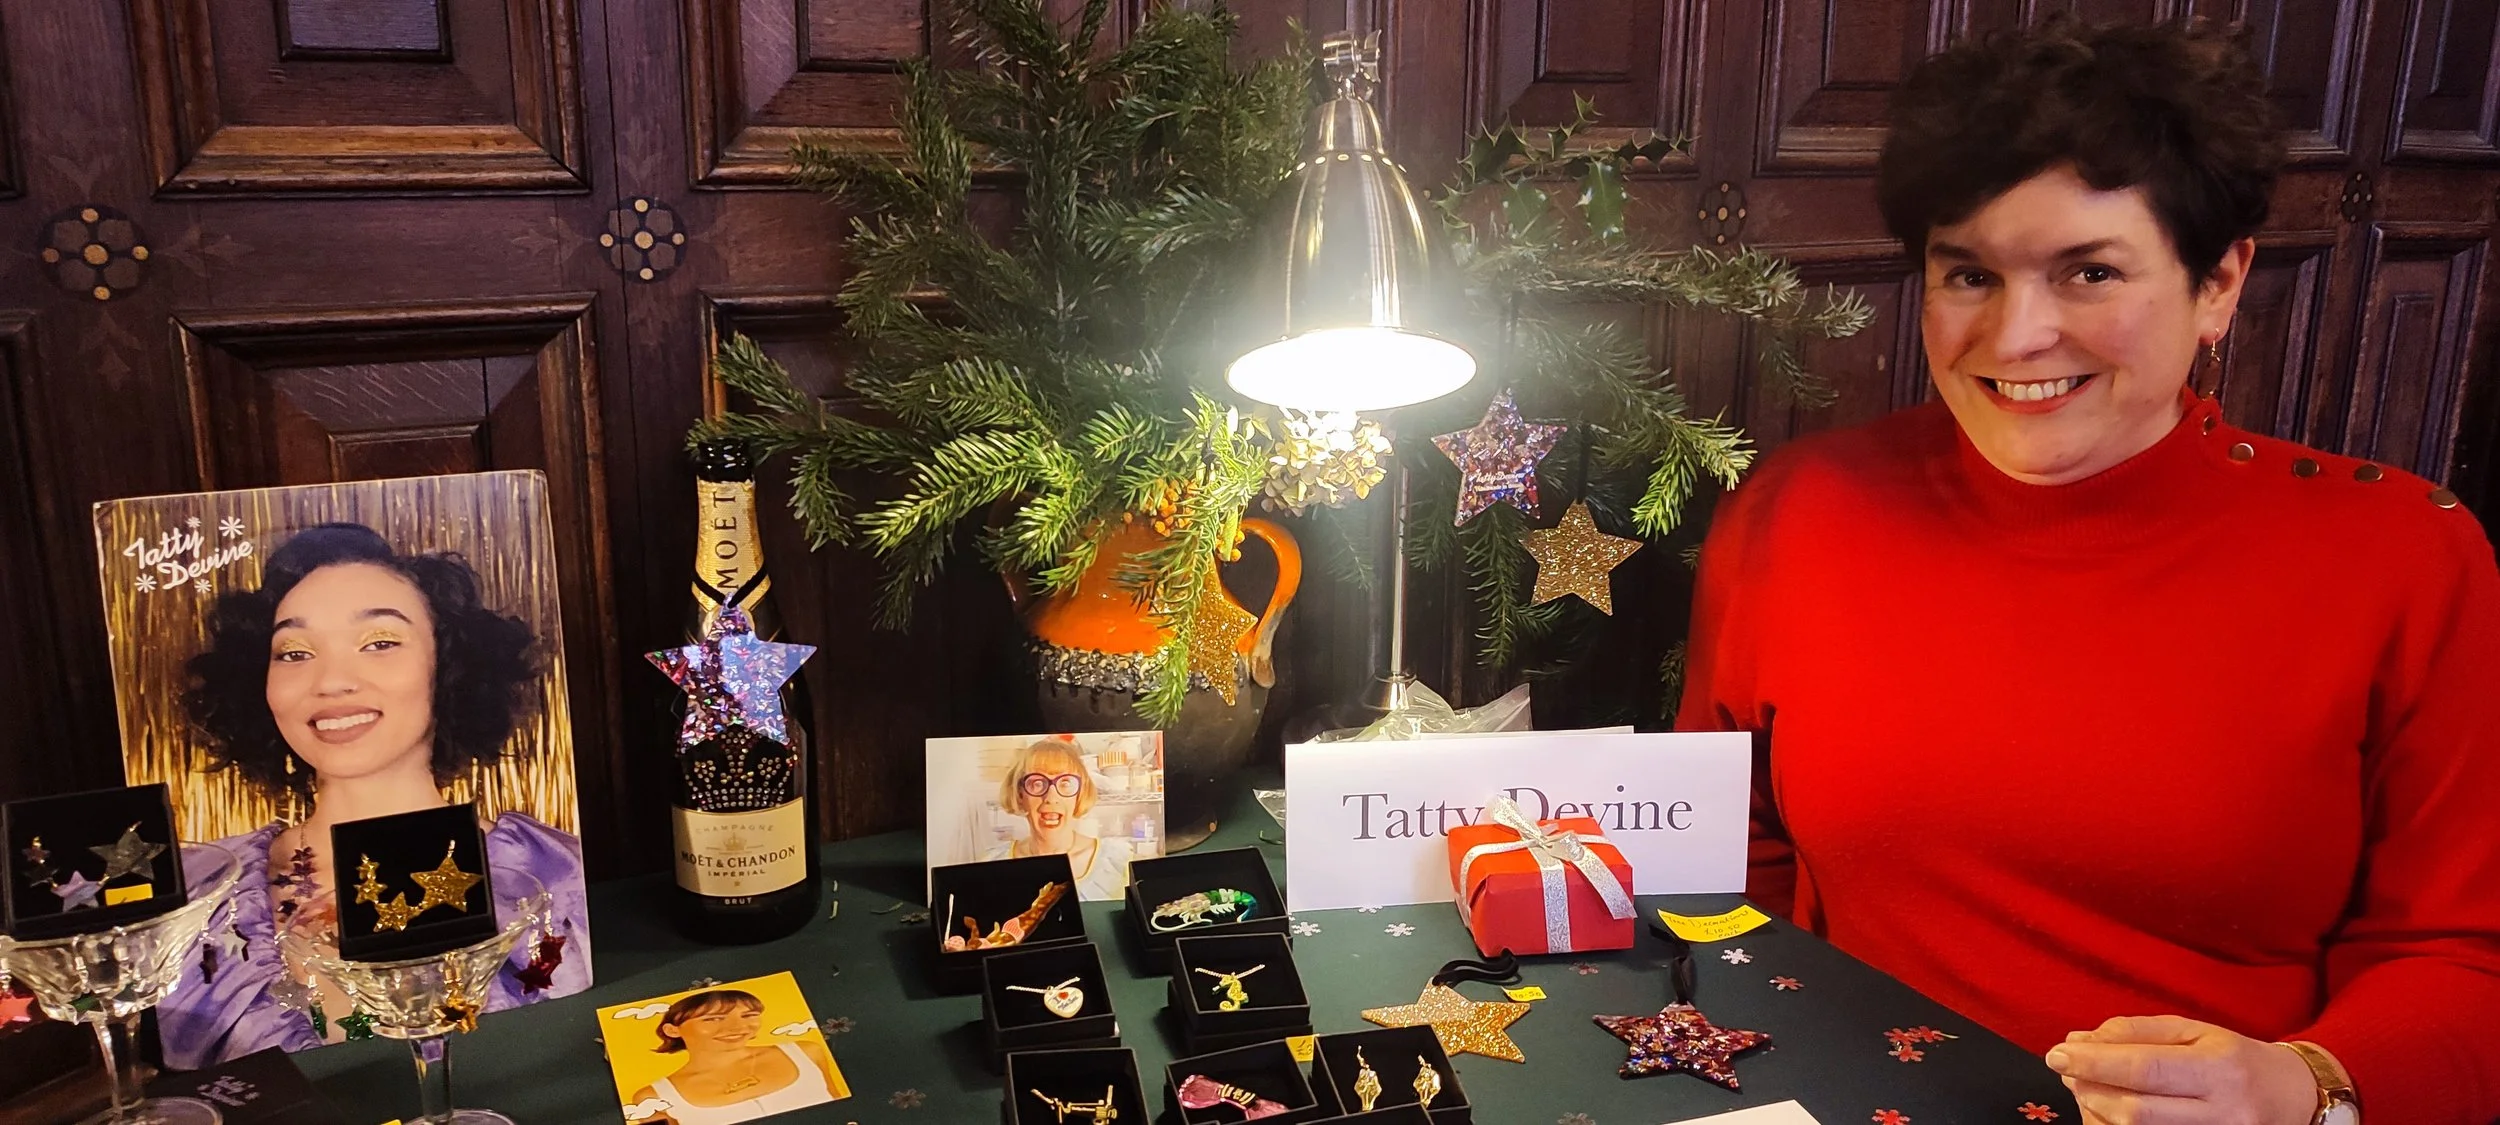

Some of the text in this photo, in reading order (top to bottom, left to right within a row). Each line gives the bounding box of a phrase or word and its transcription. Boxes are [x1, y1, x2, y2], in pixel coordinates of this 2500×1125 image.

[123, 527, 204, 569] Tatty
[711, 491, 739, 590] MOËT
[157, 541, 253, 590] Devine
[695, 823, 775, 835] CHAMPAGNE
[1342, 785, 1692, 840] Tatty Devine
[716, 859, 724, 868] &
[727, 845, 796, 868] CHANDON
[724, 897, 752, 905] BRUT
